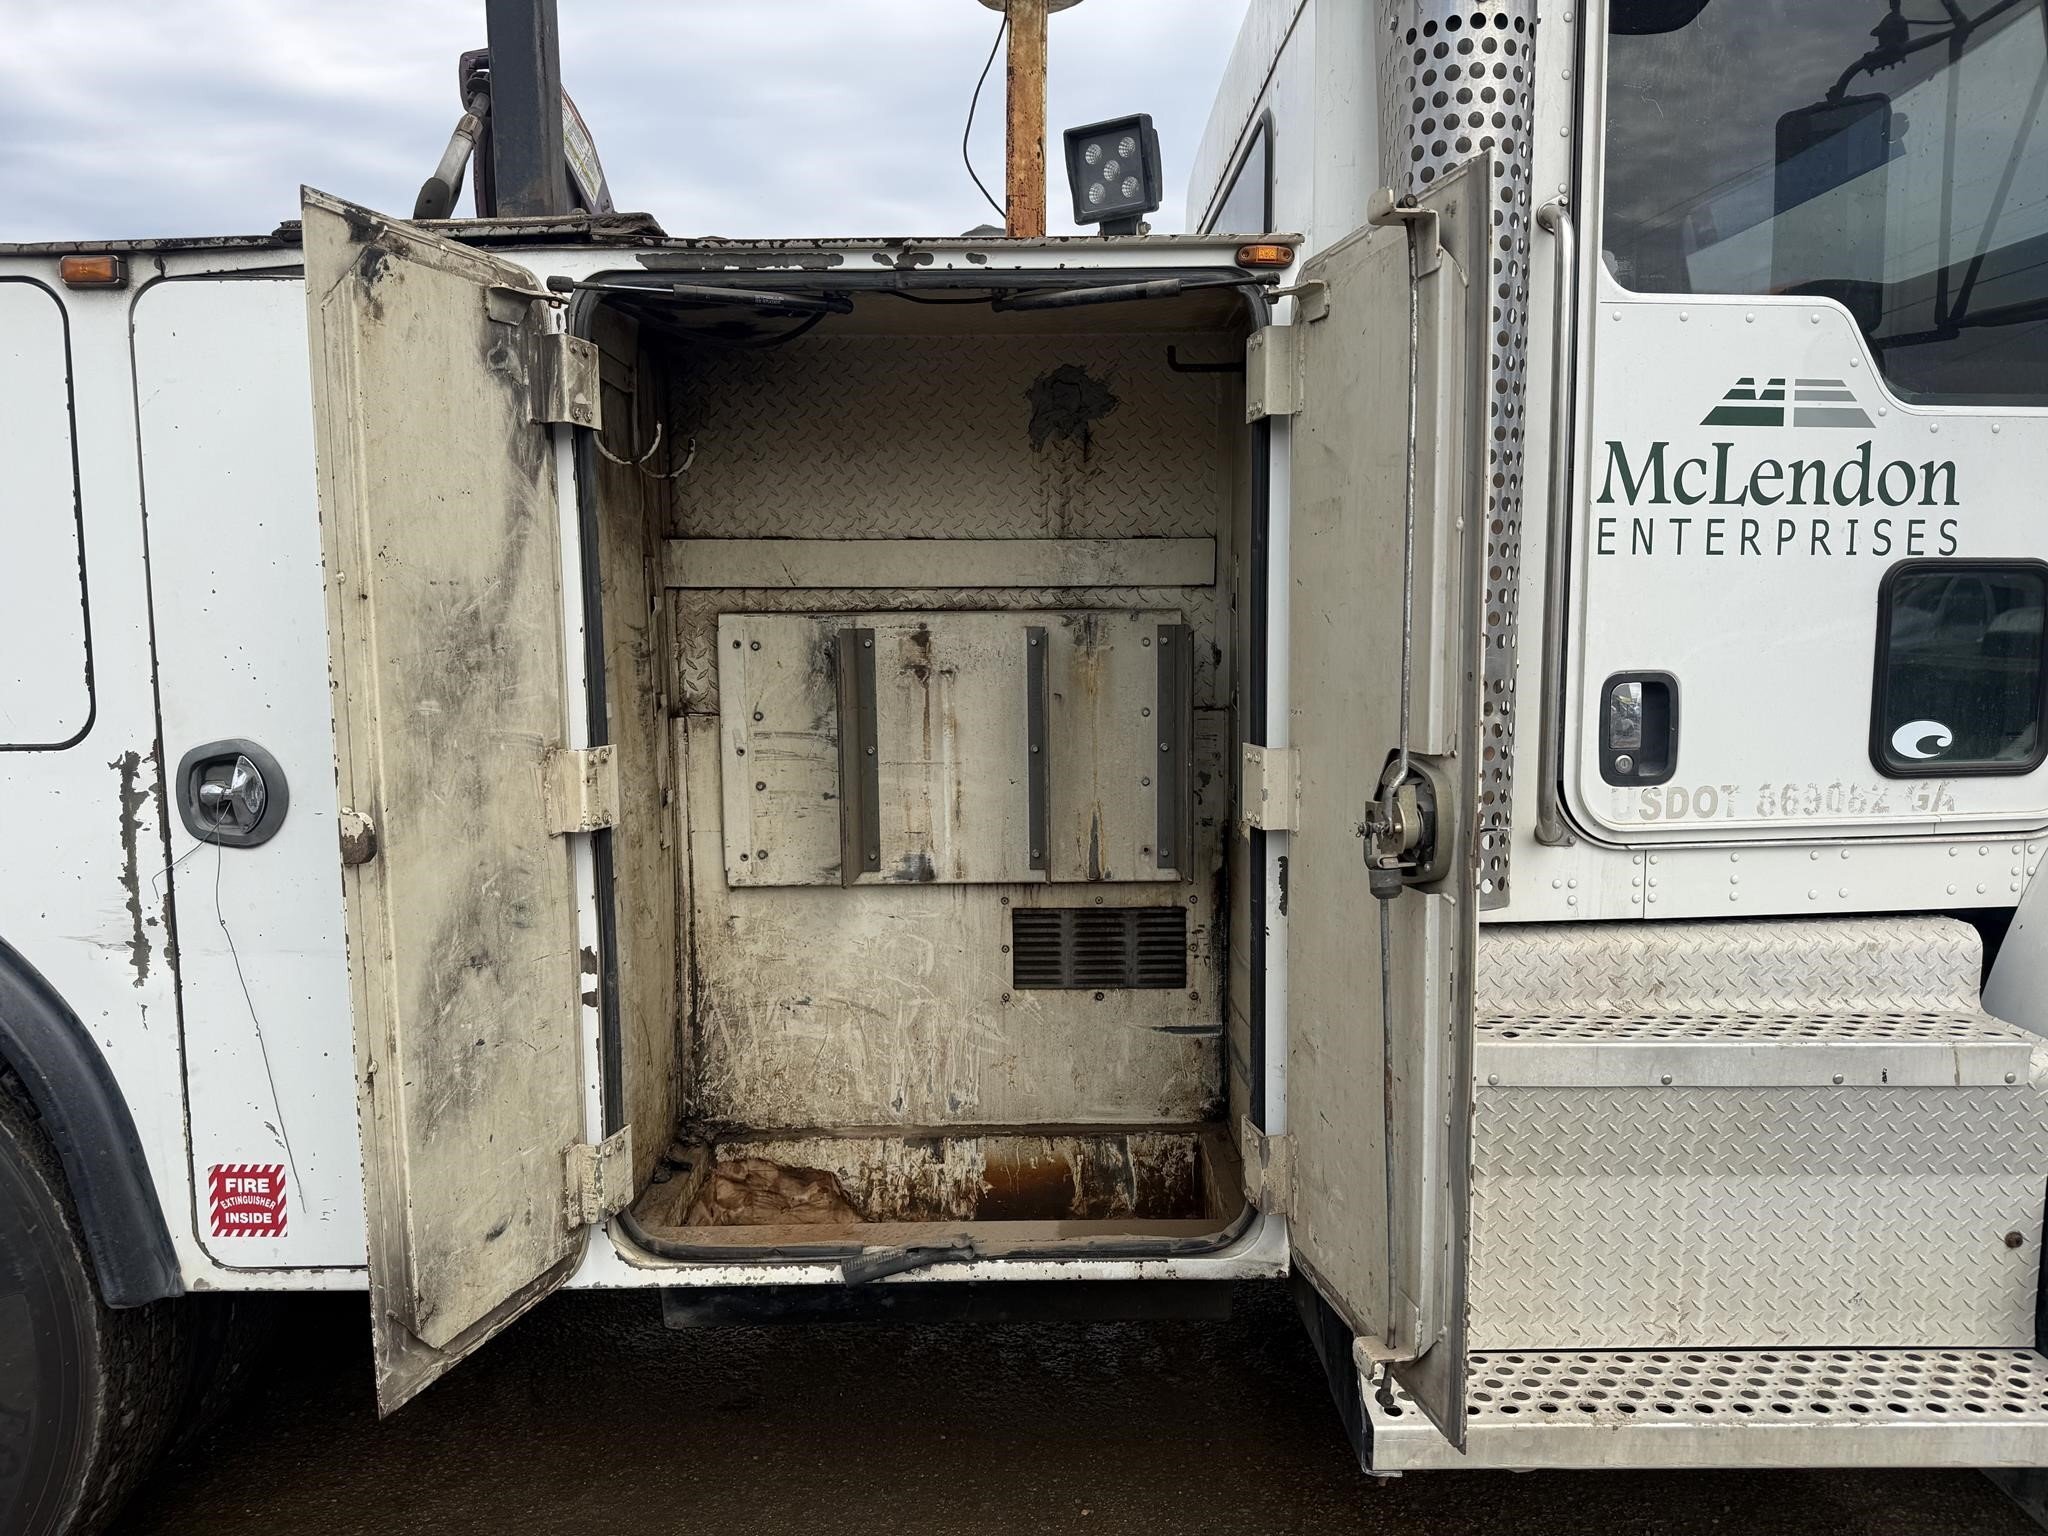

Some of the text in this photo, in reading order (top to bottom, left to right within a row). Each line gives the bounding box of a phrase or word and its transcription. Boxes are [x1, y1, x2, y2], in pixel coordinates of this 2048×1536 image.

[1597, 440, 1960, 507] McLendon
[1597, 517, 1959, 556] ENTERPRISES
[1611, 785, 1739, 821] USDOT
[225, 1178, 270, 1193] FIRE
[220, 1195, 276, 1210] EXTINGUISHER
[225, 1212, 272, 1224] INSIDE
